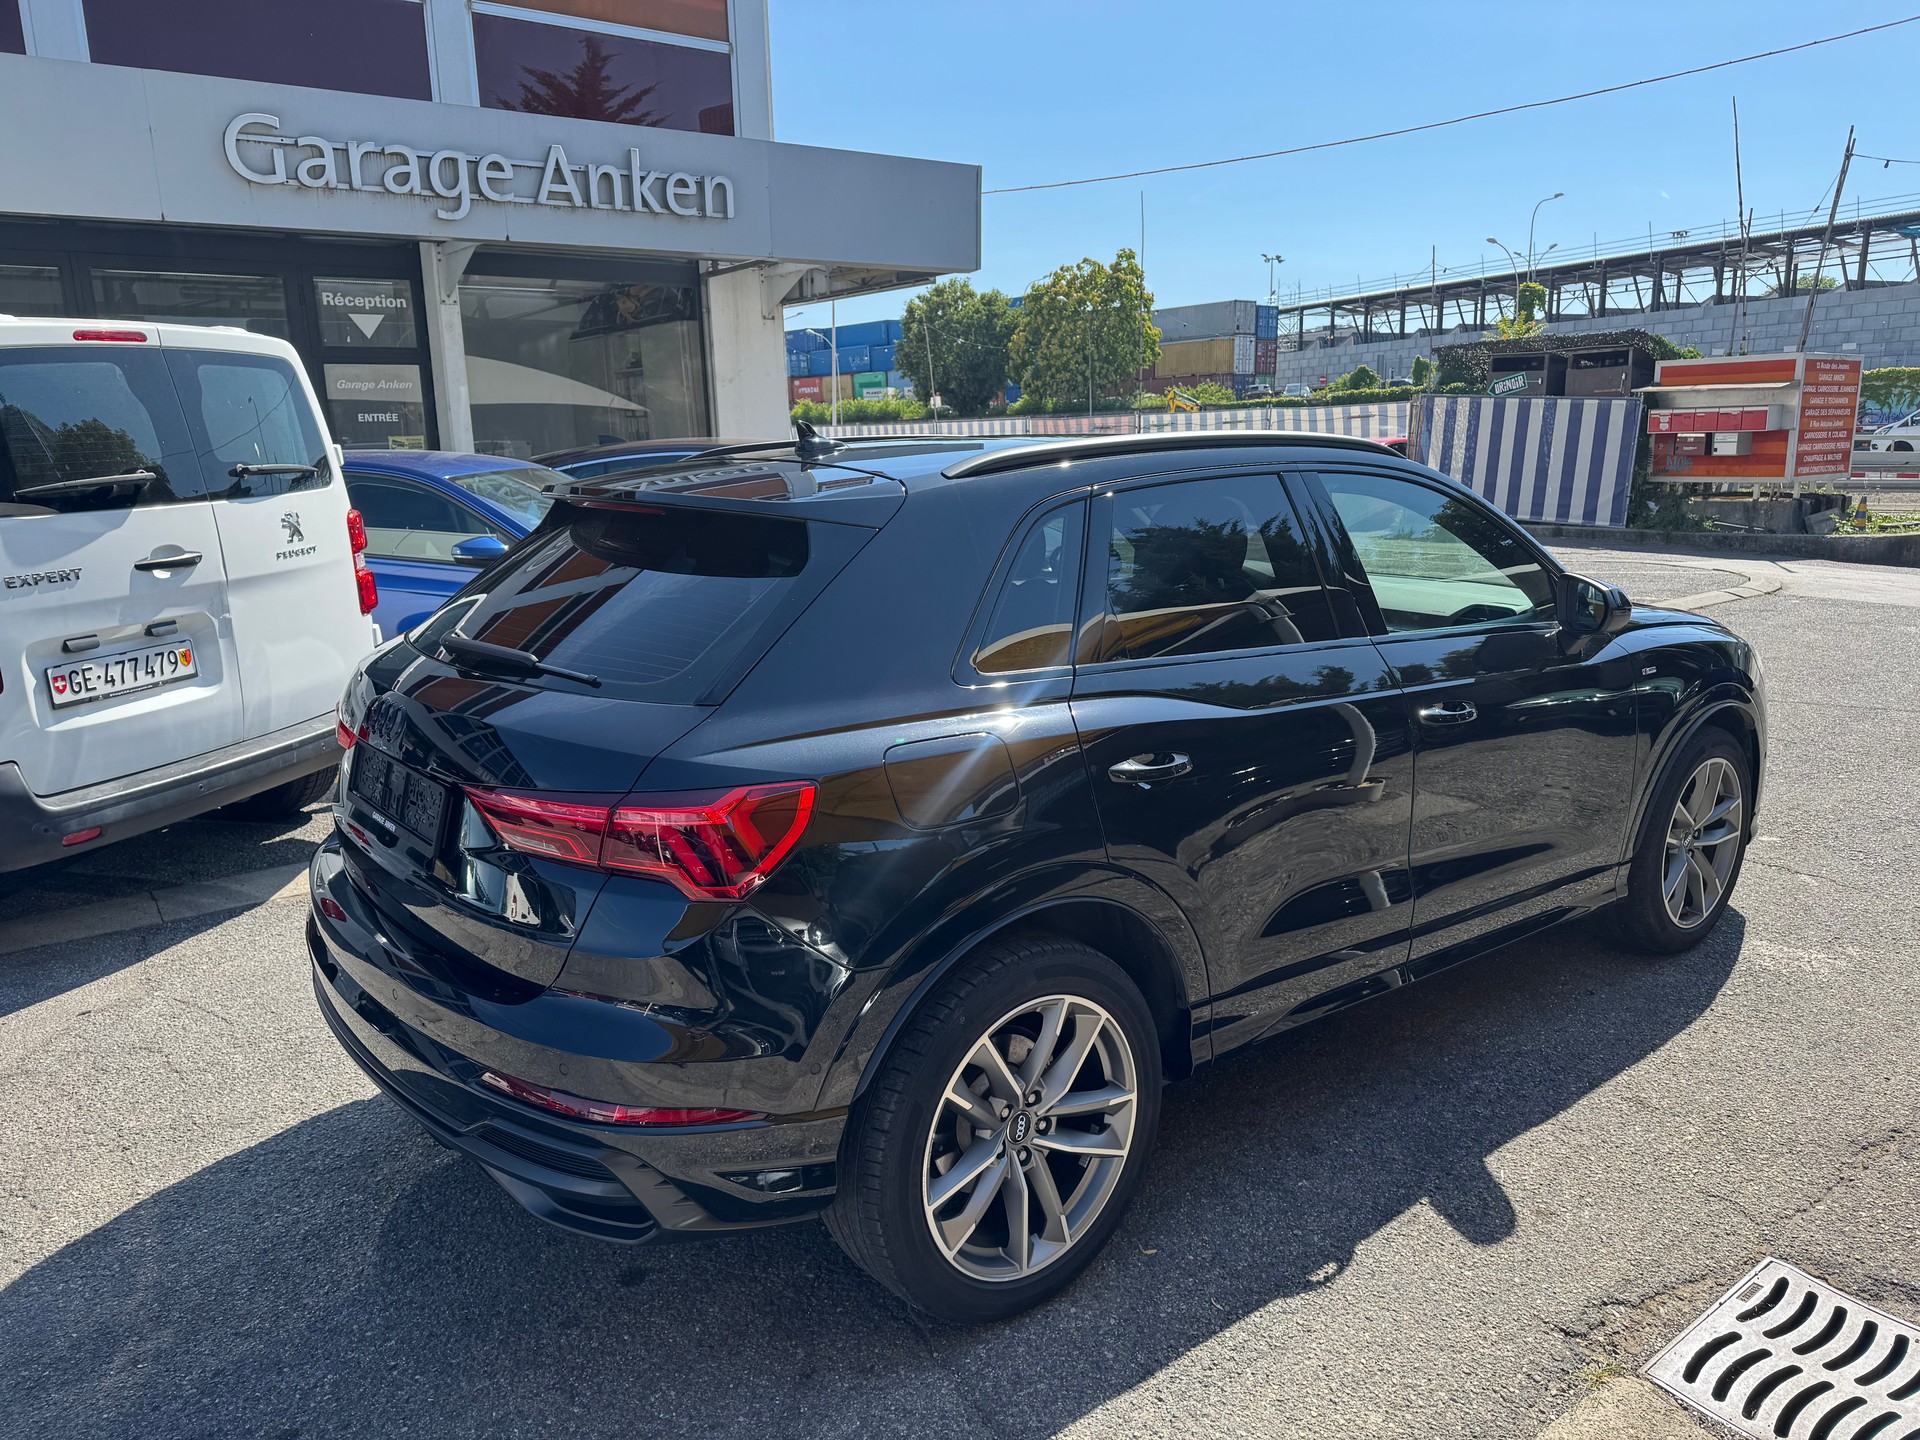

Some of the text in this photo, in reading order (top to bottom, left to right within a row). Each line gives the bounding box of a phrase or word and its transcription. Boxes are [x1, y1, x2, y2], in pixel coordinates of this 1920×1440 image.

[223, 112, 735, 221] Garage Anken
[321, 291, 407, 310] Réception
[336, 379, 413, 391] Garage Anken
[357, 411, 399, 422] ENTRÉE
[276, 545, 317, 561] PEUGEOT
[3, 566, 83, 590] EXPERT
